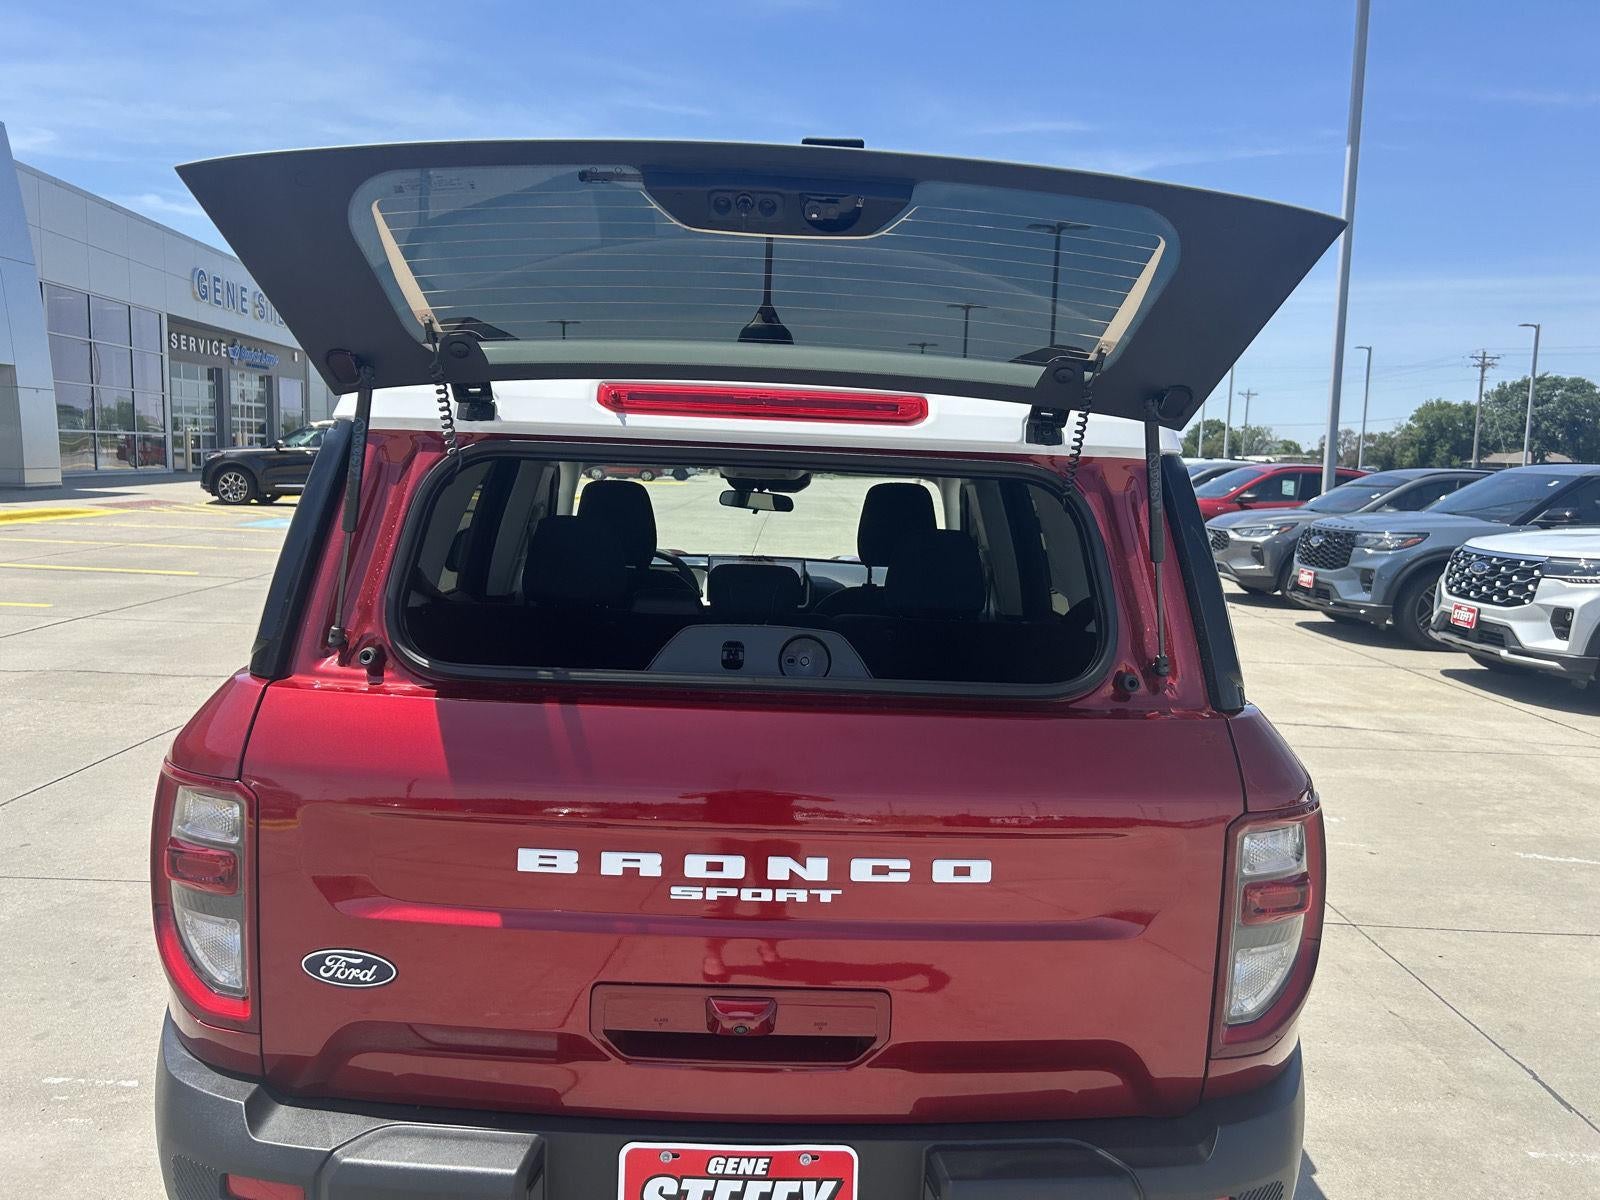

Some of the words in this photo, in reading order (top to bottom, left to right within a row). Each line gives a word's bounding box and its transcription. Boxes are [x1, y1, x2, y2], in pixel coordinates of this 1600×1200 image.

[194, 268, 249, 315] GENE
[170, 332, 227, 358] SERVICE
[517, 847, 992, 883] BRONCO
[670, 886, 842, 903] SPORT
[319, 955, 378, 981] Ford
[706, 1156, 771, 1176] GENE
